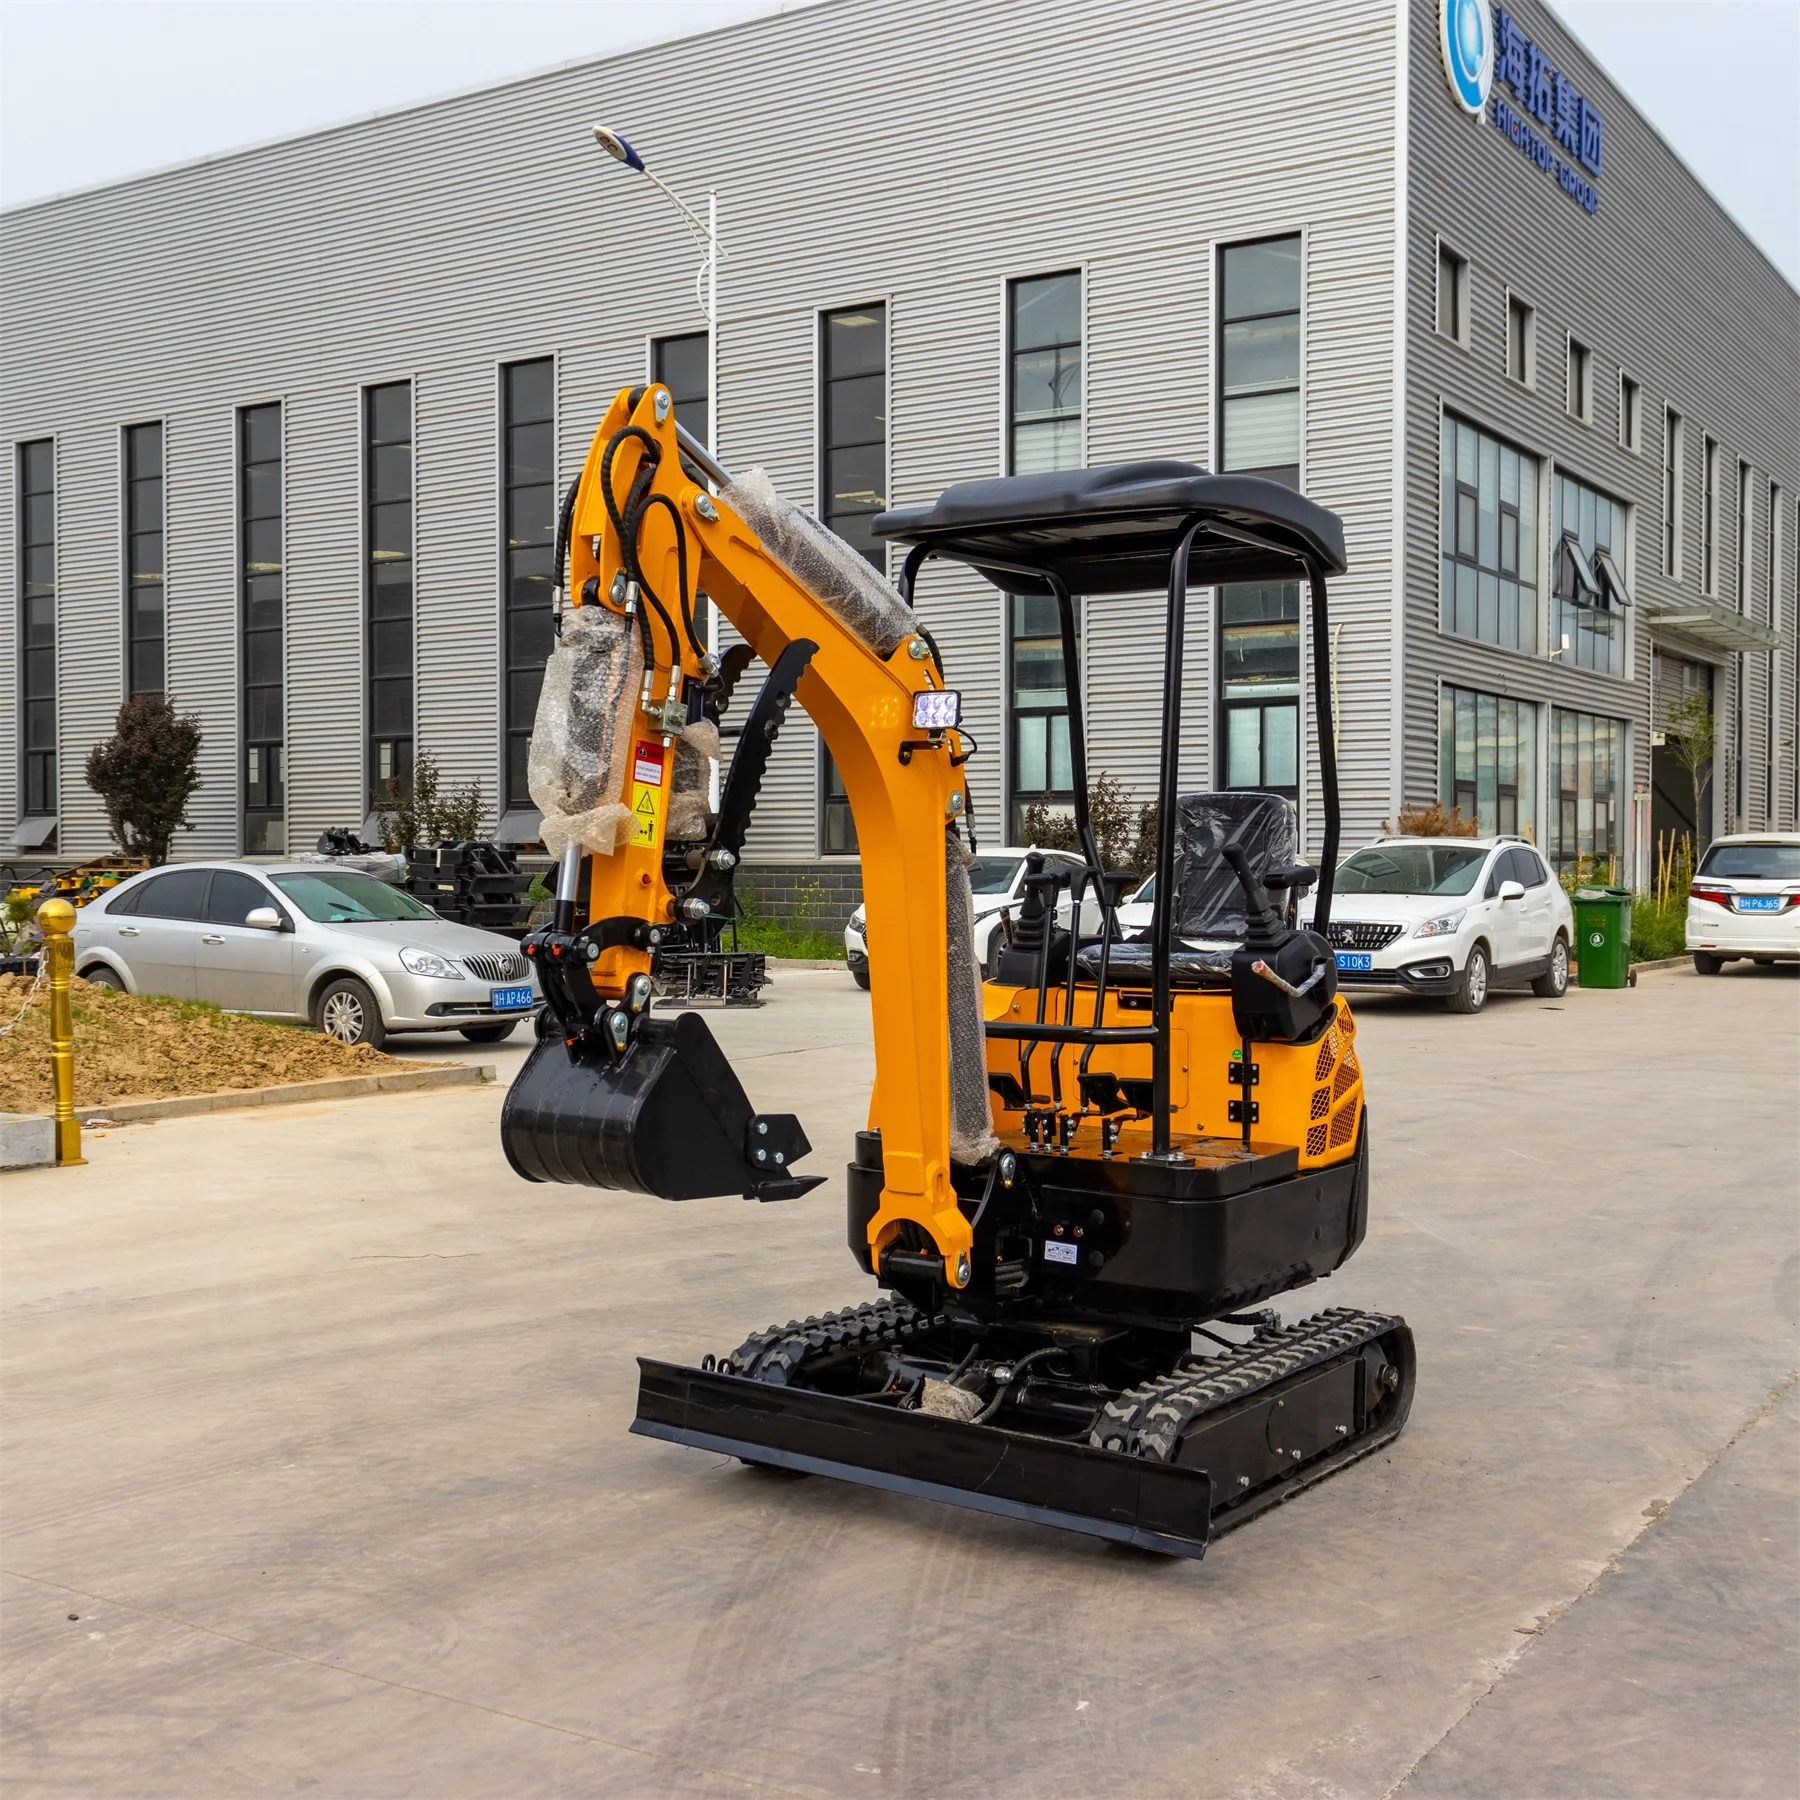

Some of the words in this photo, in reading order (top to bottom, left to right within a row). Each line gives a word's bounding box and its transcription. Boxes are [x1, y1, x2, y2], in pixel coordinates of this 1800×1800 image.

[1495, 7, 1604, 178] 海拓集团
[1495, 96, 1555, 173] HIGHTOP
[1557, 160, 1600, 215] GROUP
